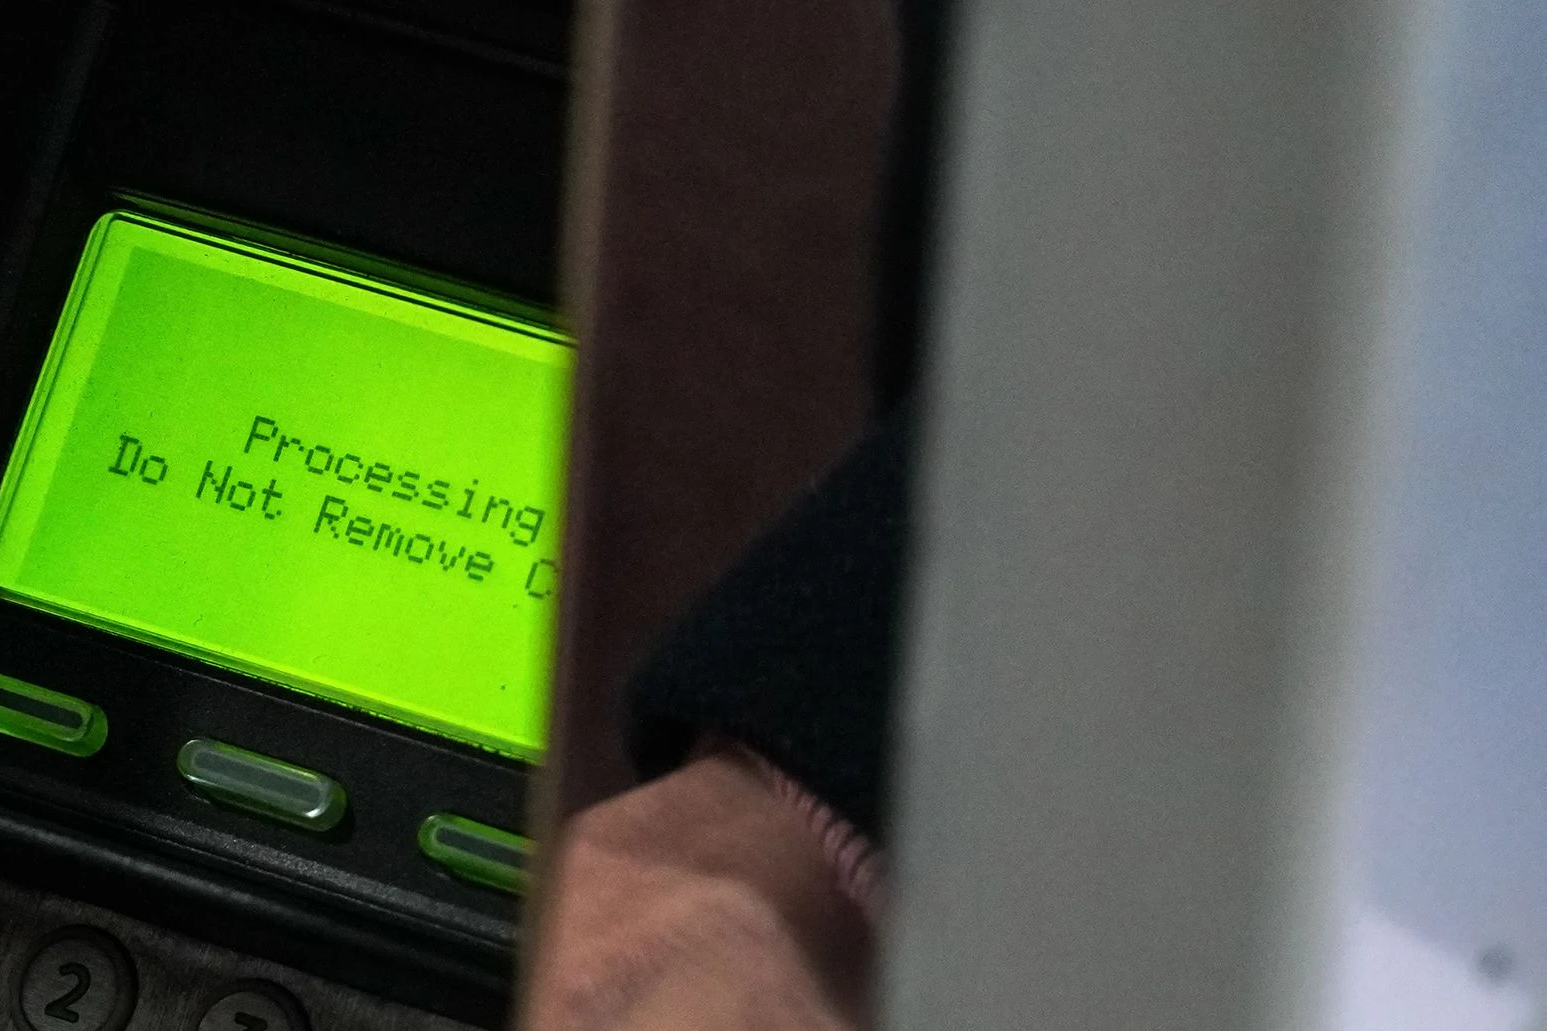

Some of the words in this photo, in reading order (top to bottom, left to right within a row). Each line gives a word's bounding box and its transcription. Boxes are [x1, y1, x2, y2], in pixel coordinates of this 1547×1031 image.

[109, 434, 168, 485] Do
[195, 460, 283, 521] Not
[314, 495, 495, 583] Remove
[244, 416, 545, 547] Processing
[44, 962, 92, 1023] 2
